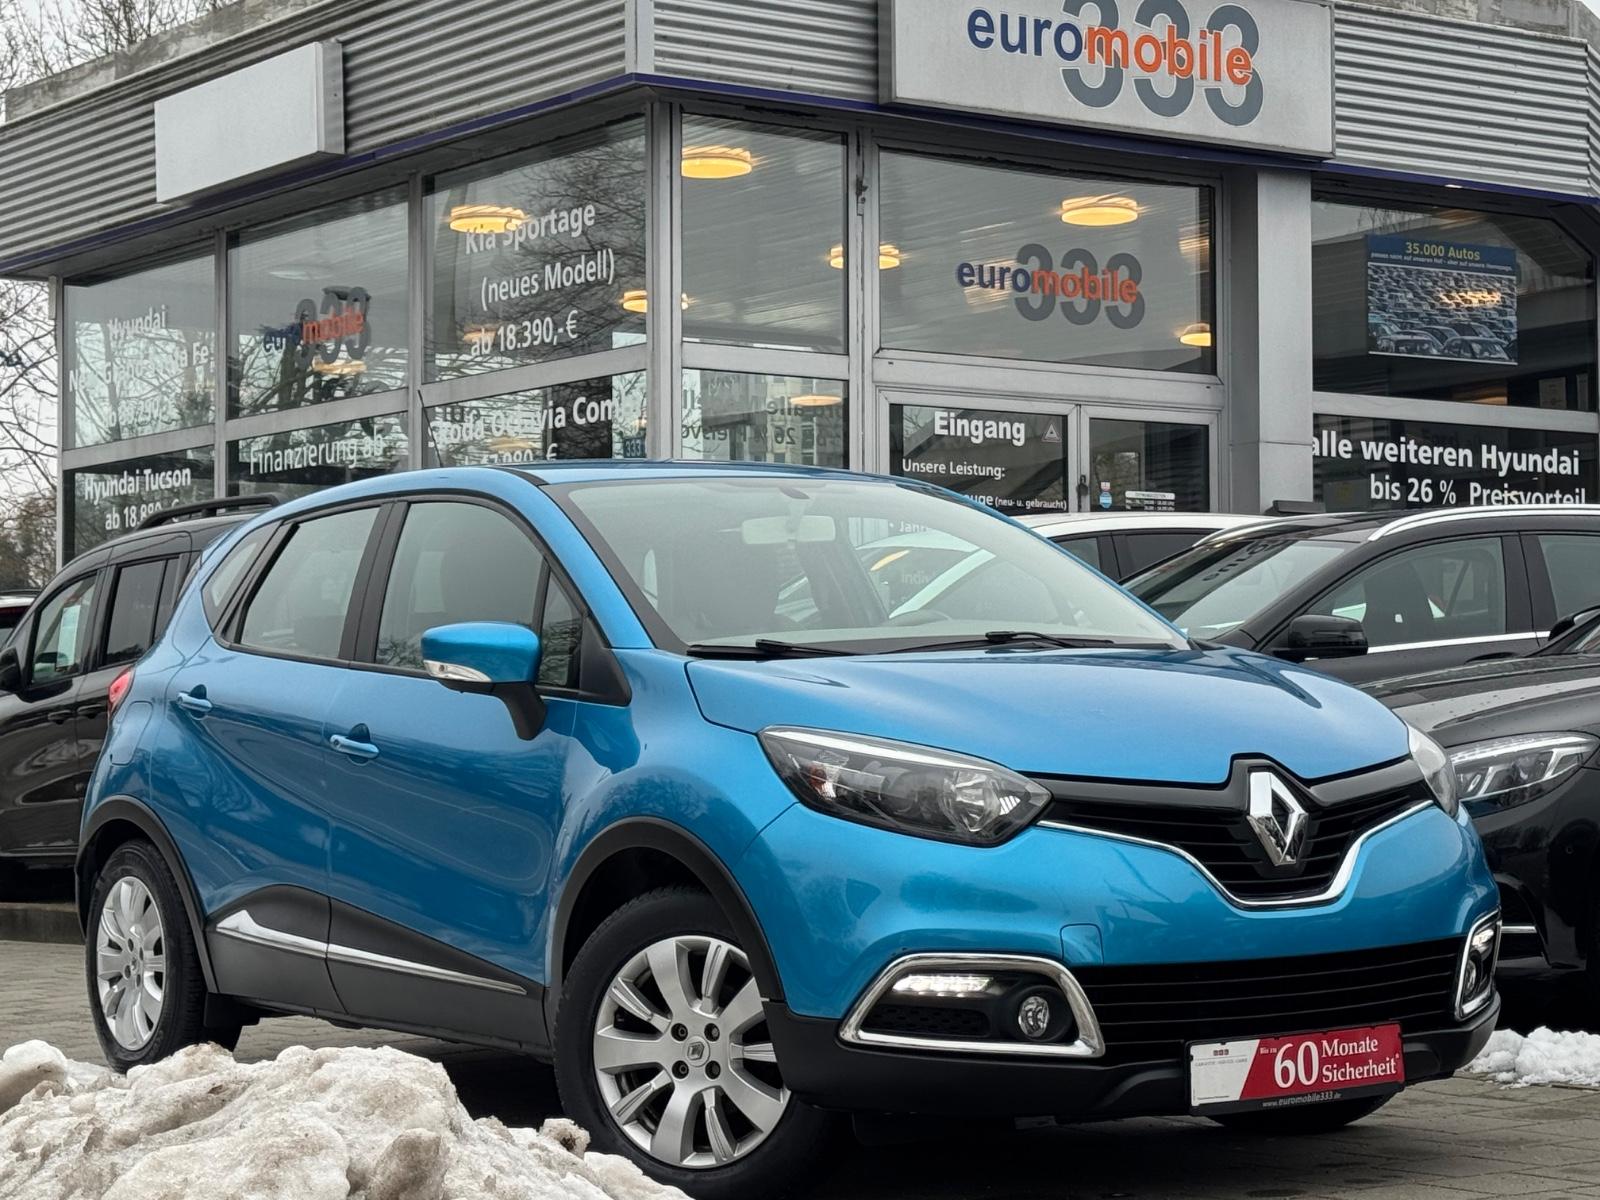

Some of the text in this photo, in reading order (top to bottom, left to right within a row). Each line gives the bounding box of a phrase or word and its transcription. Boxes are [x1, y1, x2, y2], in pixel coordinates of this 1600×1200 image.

[967, 7, 1253, 86] euromobile
[1059, 0, 1264, 127] 333
[502, 204, 596, 251] Sportage
[1405, 242, 1445, 257] 35.000
[1448, 247, 1481, 261] Autos
[481, 248, 615, 312] (neues Modell)
[957, 261, 1138, 304] euromobile
[1015, 243, 1145, 329] 333
[471, 328, 492, 357] ab
[934, 411, 1026, 446] Eingang
[250, 441, 358, 475] Finanzierung
[902, 459, 1006, 481] Unsere Leistung:
[1312, 430, 1579, 477] alle weiteren Hyundai
[85, 468, 192, 505] Hyundai Tucson
[995, 496, 1015, 508] (neu-
[1016, 498, 1024, 507] u.
[1026, 498, 1067, 511] gebraucht)
[1370, 473, 1586, 506] bis 26 % Preisvorteil
[105, 506, 120, 531] ab
[1274, 1041, 1320, 1089] 60
[1321, 1036, 1379, 1058] Monate
